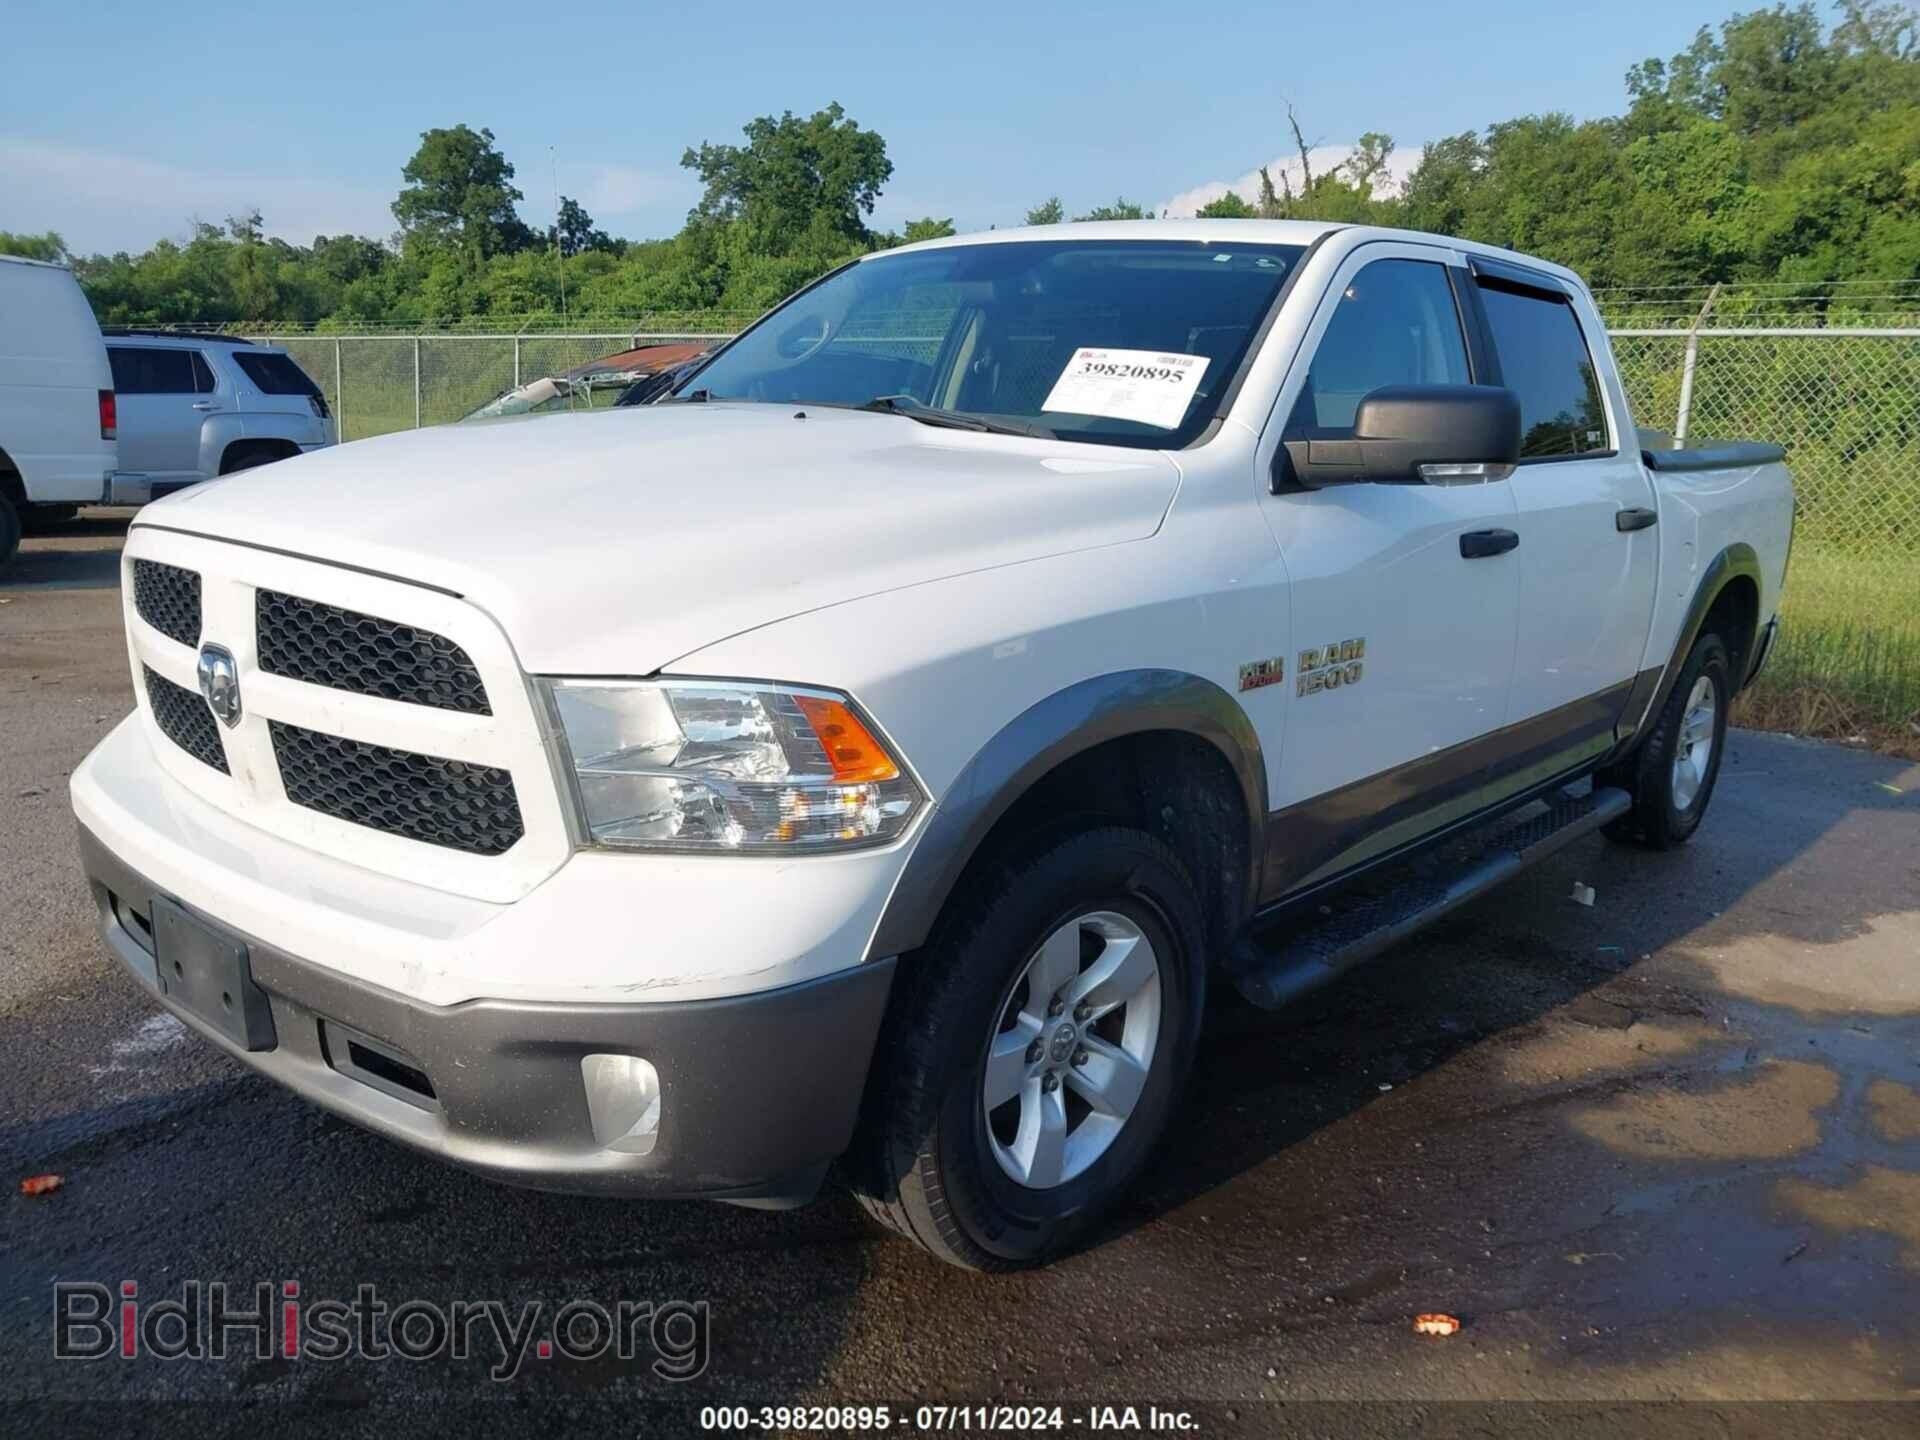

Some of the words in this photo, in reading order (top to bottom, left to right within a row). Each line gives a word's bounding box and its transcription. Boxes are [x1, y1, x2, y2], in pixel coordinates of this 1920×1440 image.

[1078, 362, 1186, 384] 39820895
[1297, 636, 1366, 673] RAM
[1296, 661, 1364, 698] 1500
